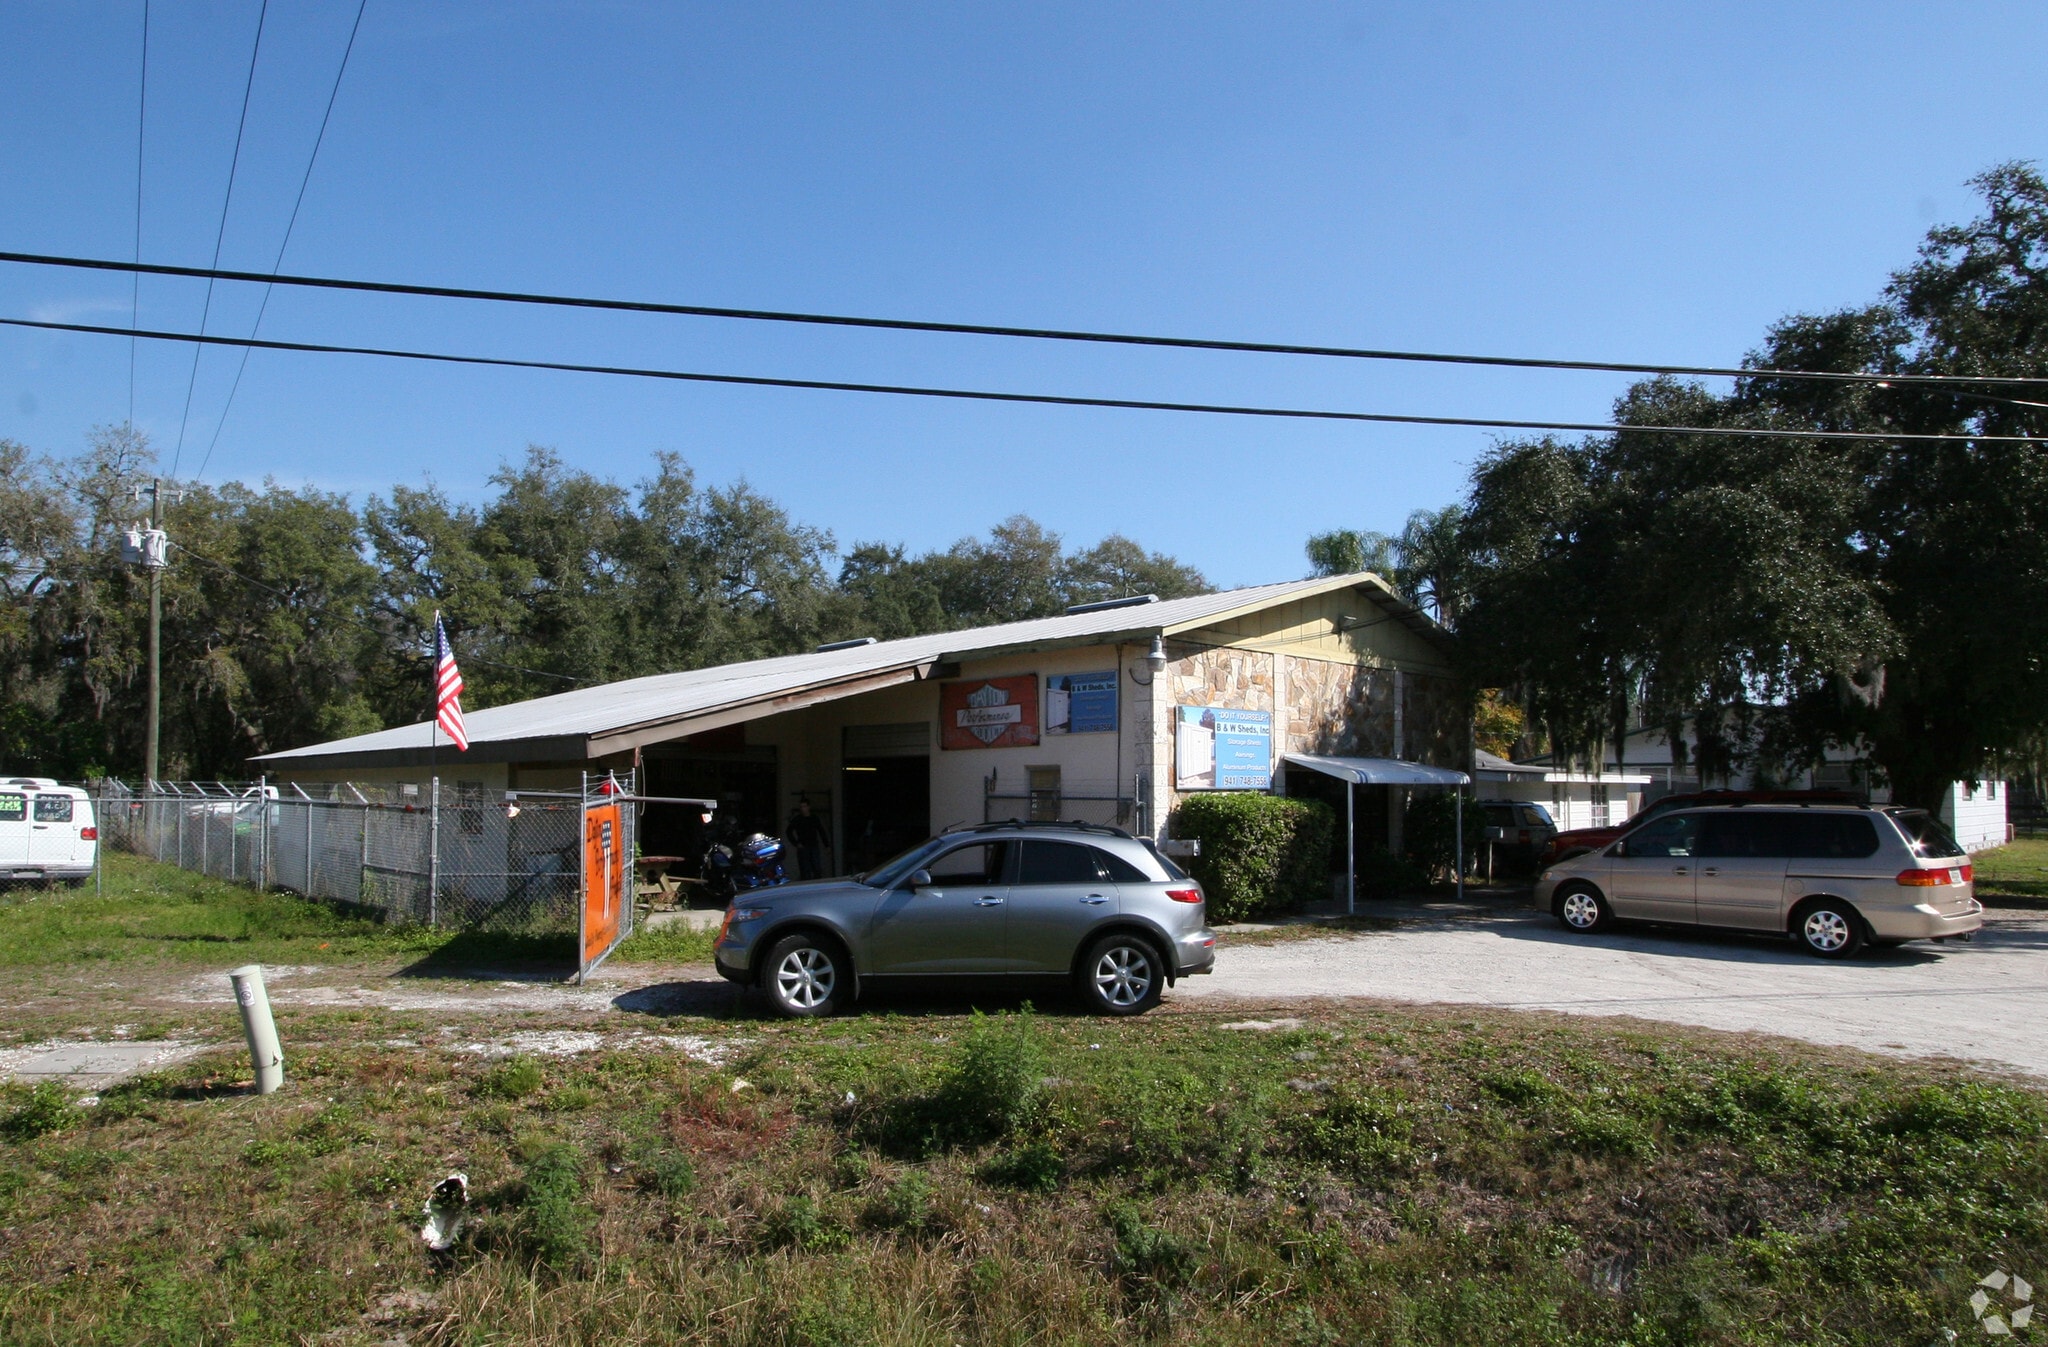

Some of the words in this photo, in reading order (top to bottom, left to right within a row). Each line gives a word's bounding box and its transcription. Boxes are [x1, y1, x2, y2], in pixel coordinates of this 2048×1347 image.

[1230, 712, 1236, 720] IT
[1217, 723, 1221, 732] B
[1223, 723, 1228, 732] &
[1229, 723, 1236, 733] W
[1237, 724, 1259, 735] Sheds,
